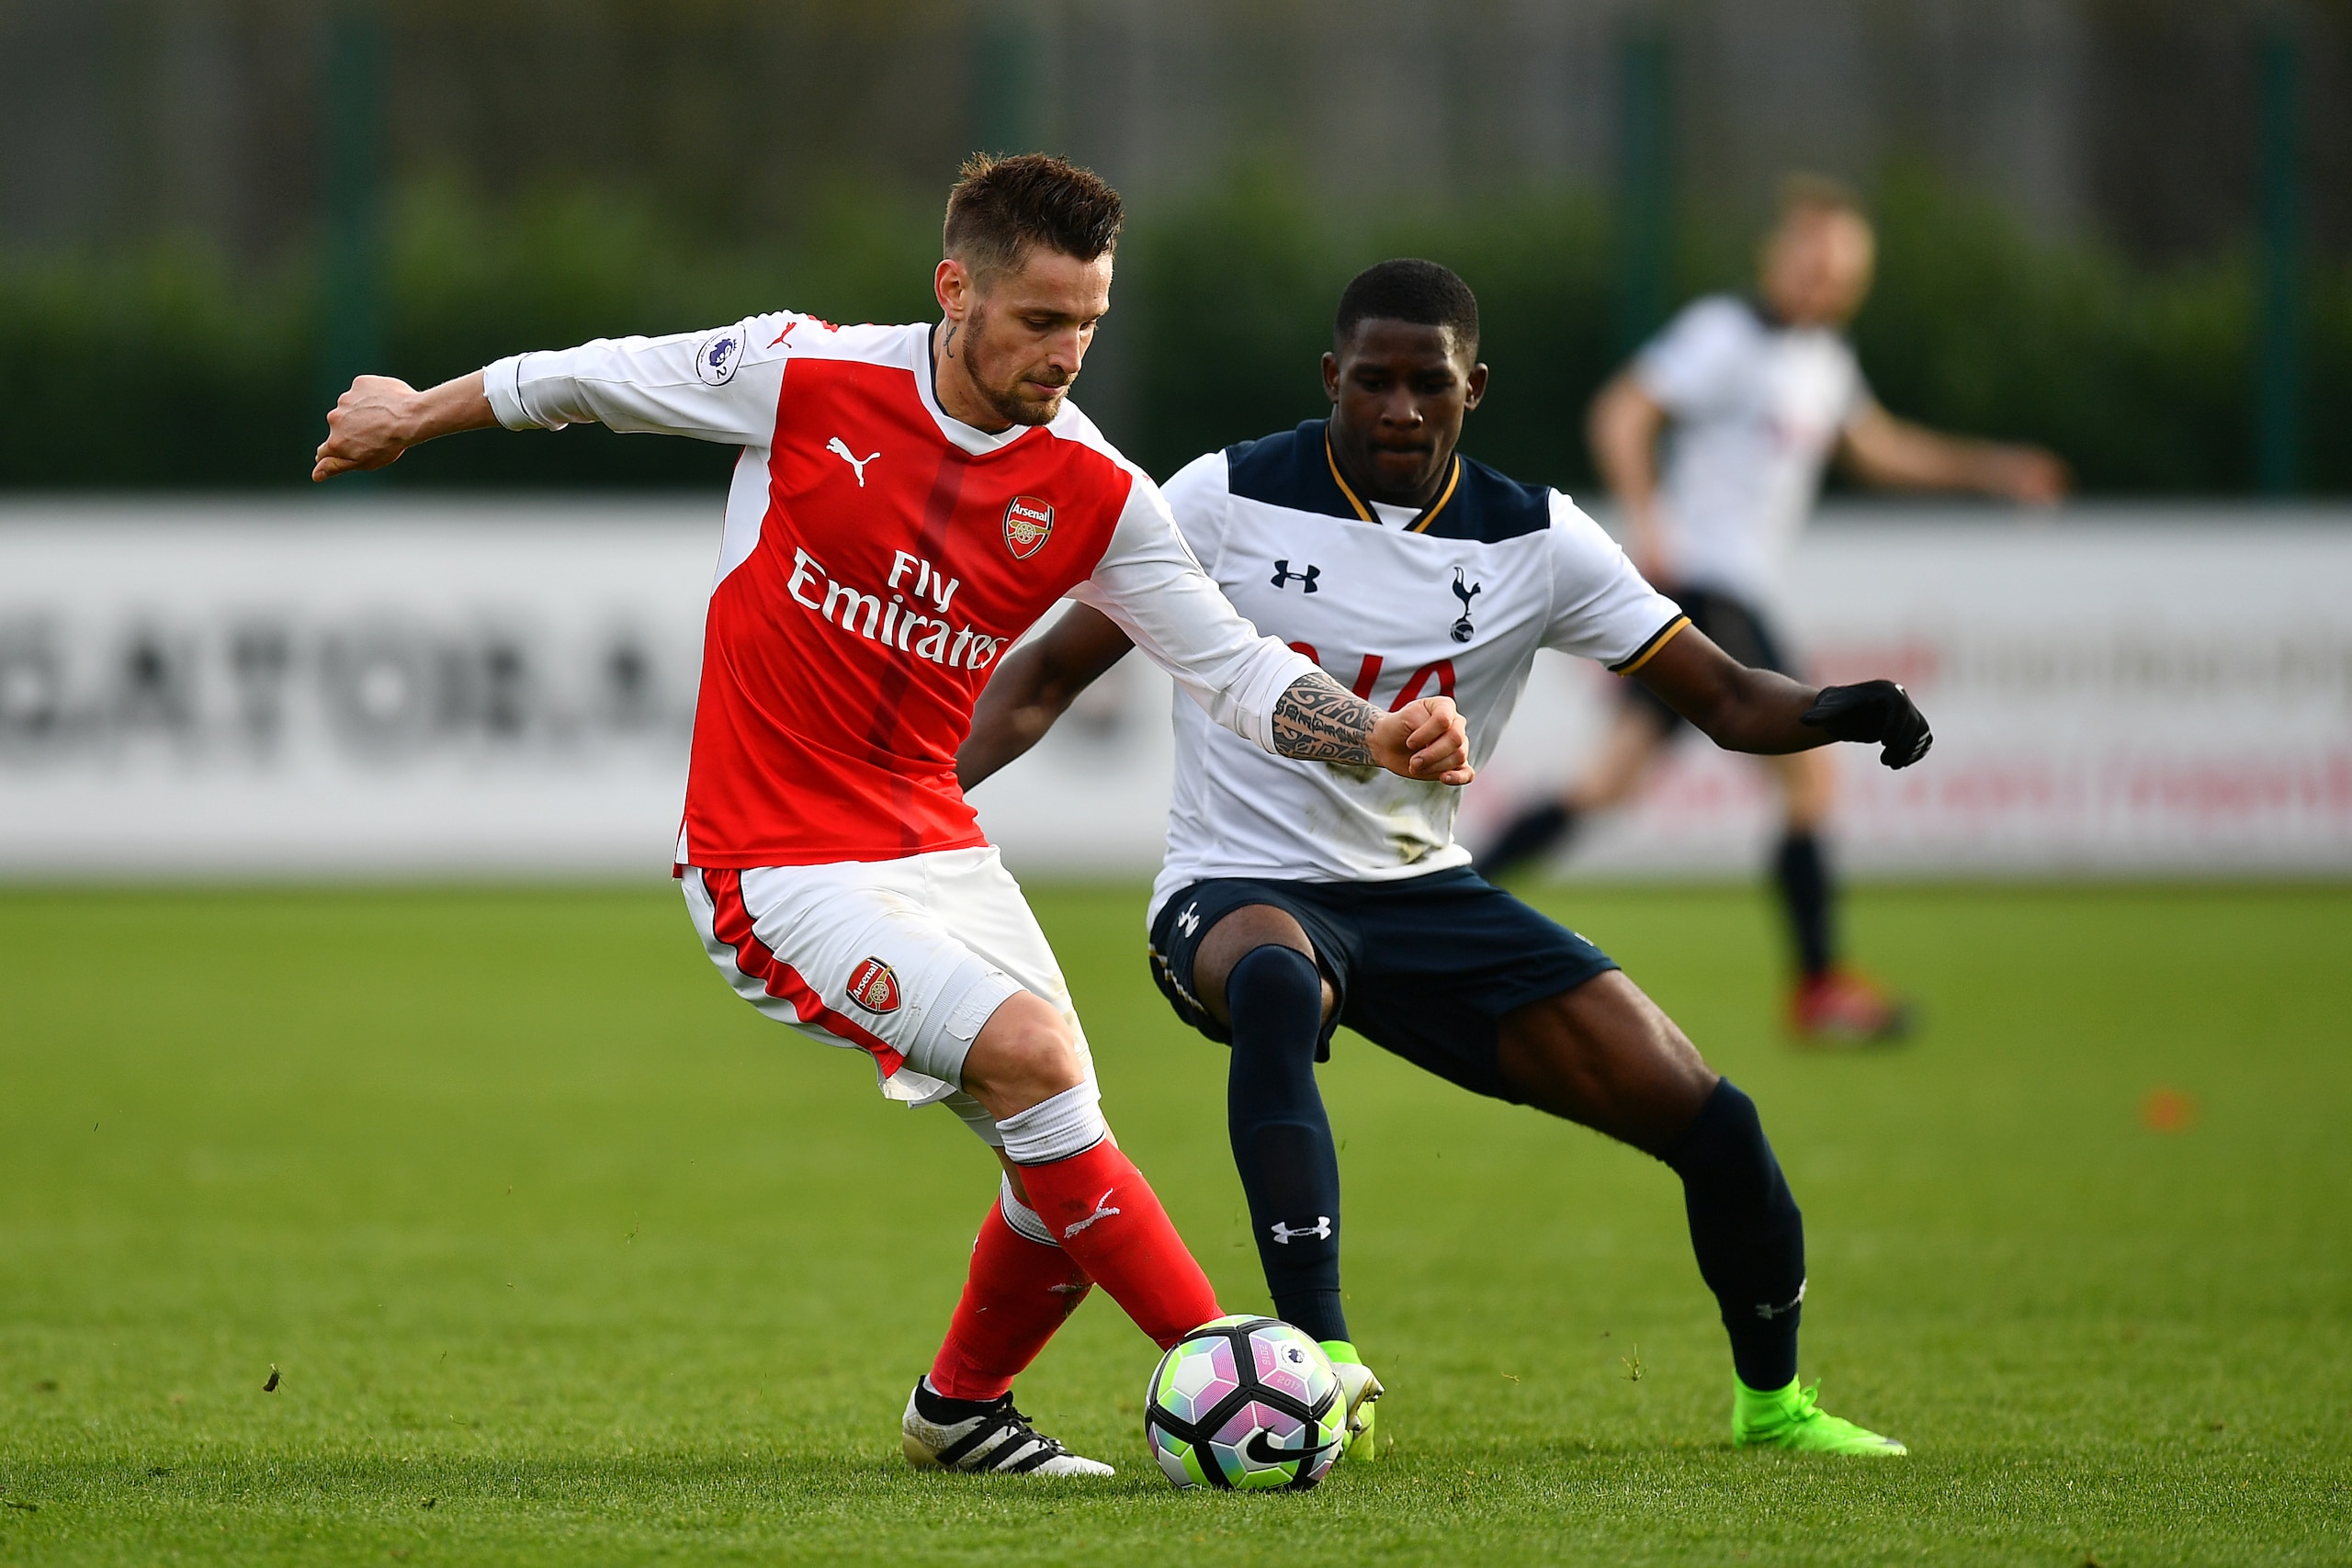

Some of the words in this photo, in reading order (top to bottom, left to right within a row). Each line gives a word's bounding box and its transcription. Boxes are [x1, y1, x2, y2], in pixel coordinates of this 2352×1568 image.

[716, 366, 728, 379] 2
[1012, 503, 1047, 522] Arsenal
[888, 549, 960, 614] Fly
[786, 546, 1009, 671] Emirates
[853, 963, 879, 999] Arsenal
[1277, 1375, 1302, 1391] 2017
